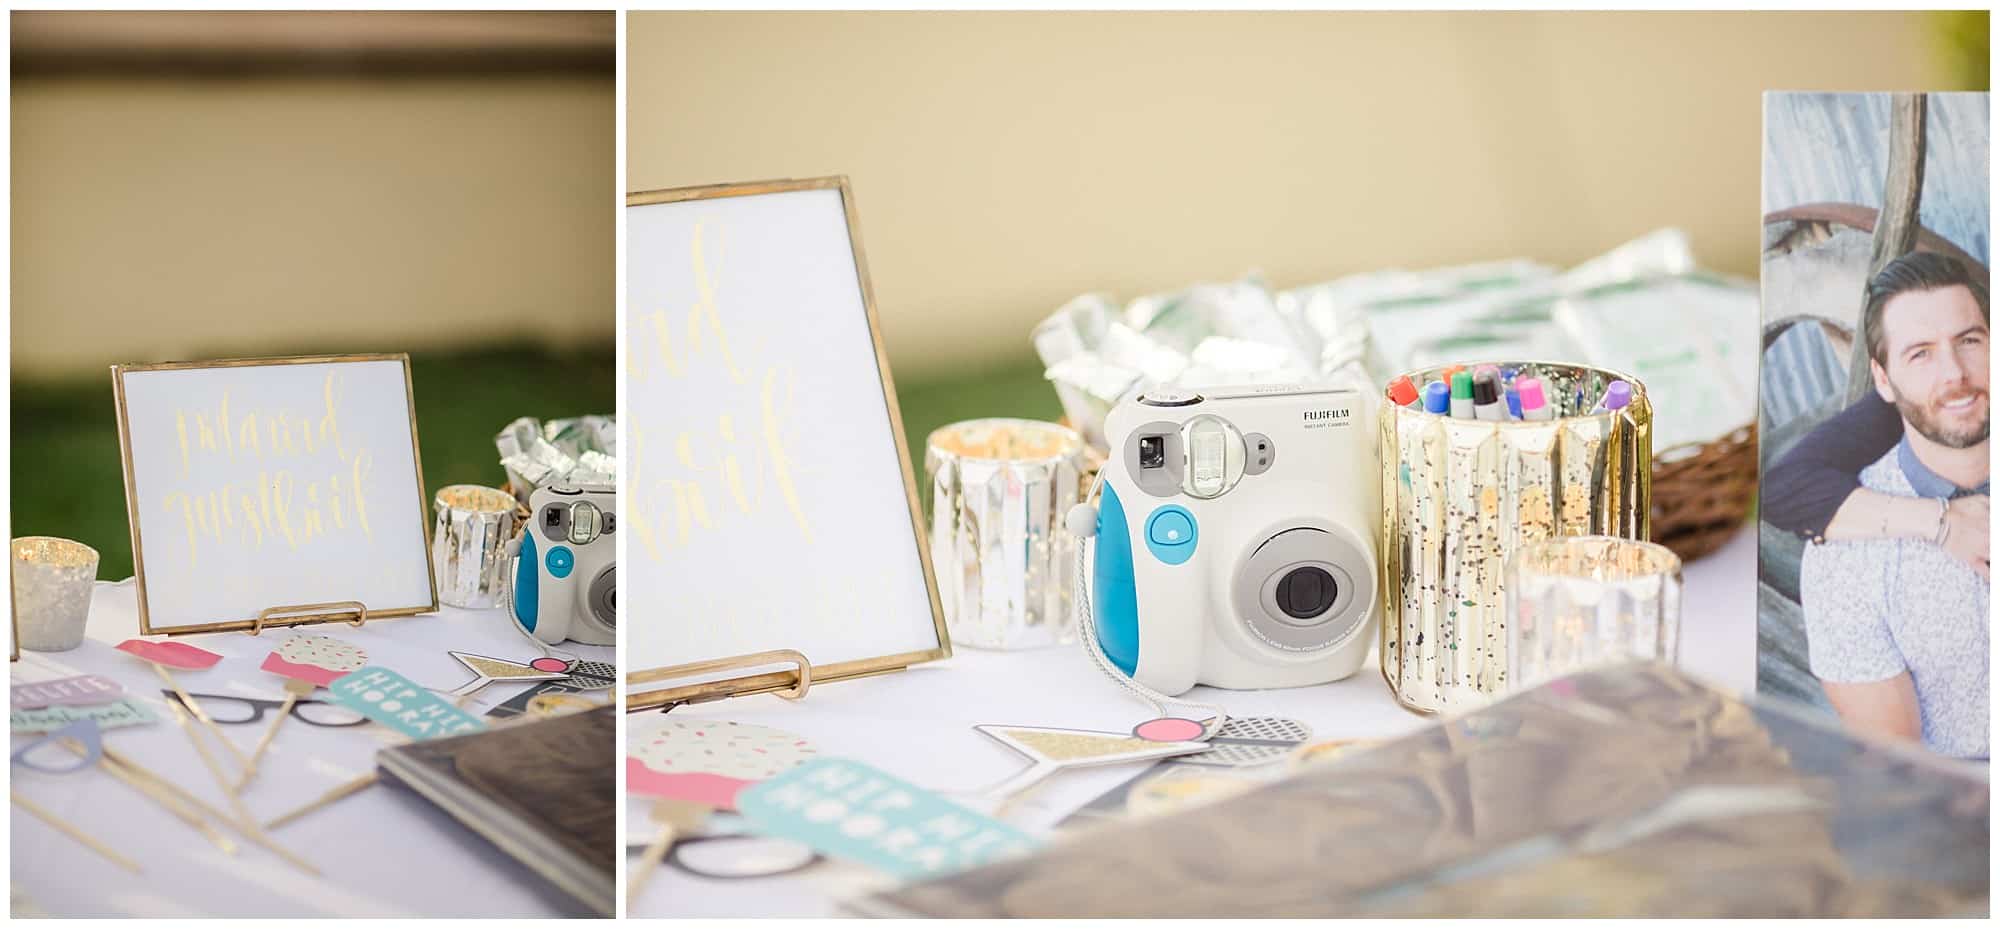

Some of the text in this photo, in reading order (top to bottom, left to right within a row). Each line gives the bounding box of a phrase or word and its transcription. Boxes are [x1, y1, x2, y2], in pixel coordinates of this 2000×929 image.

[1303, 408, 1350, 421] FUJIFILM
[363, 671, 476, 736] HIP HIP
[806, 765, 914, 810] HIP
